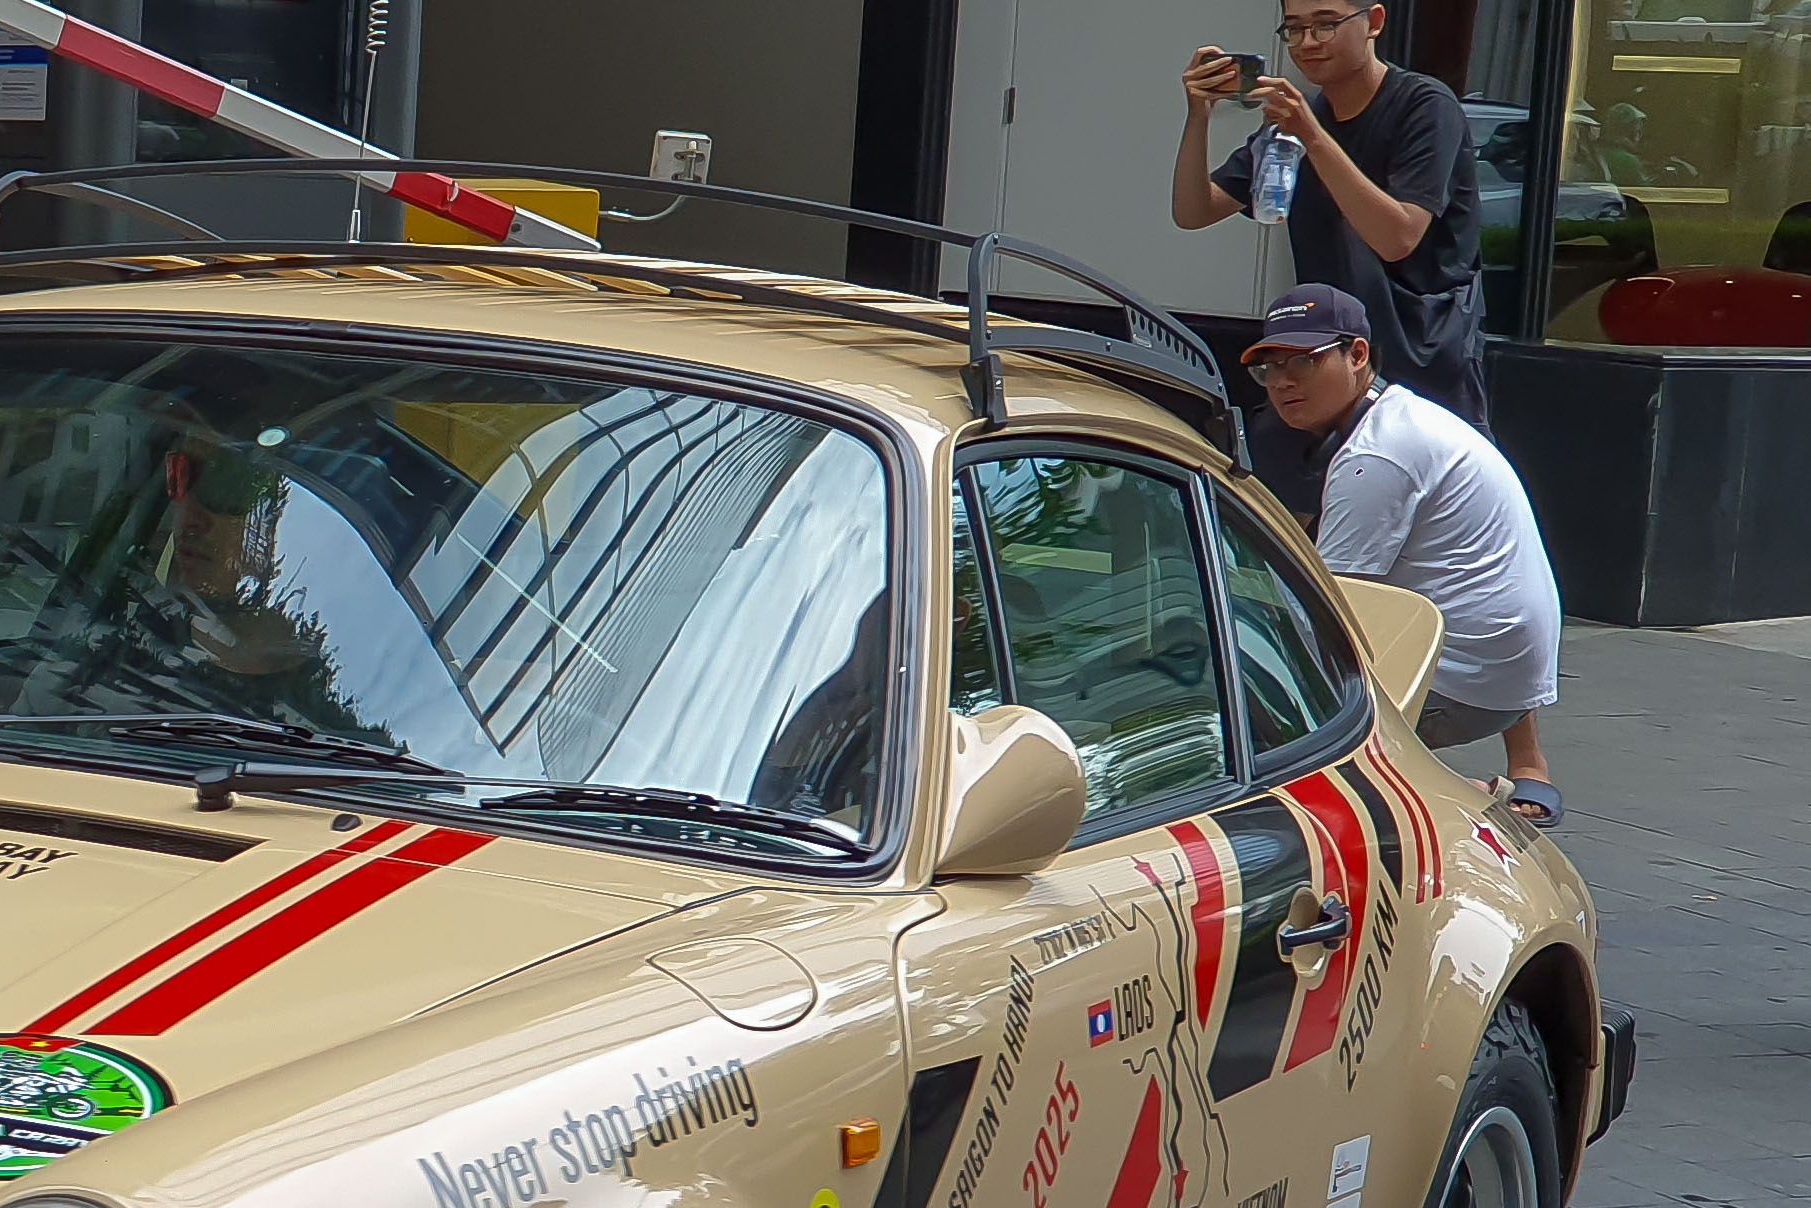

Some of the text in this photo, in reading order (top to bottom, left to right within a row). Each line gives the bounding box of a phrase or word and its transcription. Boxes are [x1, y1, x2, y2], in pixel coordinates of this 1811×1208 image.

[988, 1058, 1018, 1107] TO
[1005, 955, 1036, 1066] HANOI
[1113, 973, 1155, 1042] LAOS
[1337, 880, 1403, 1093] 2500 KM
[548, 1103, 637, 1185] stop
[632, 1055, 761, 1147] driving
